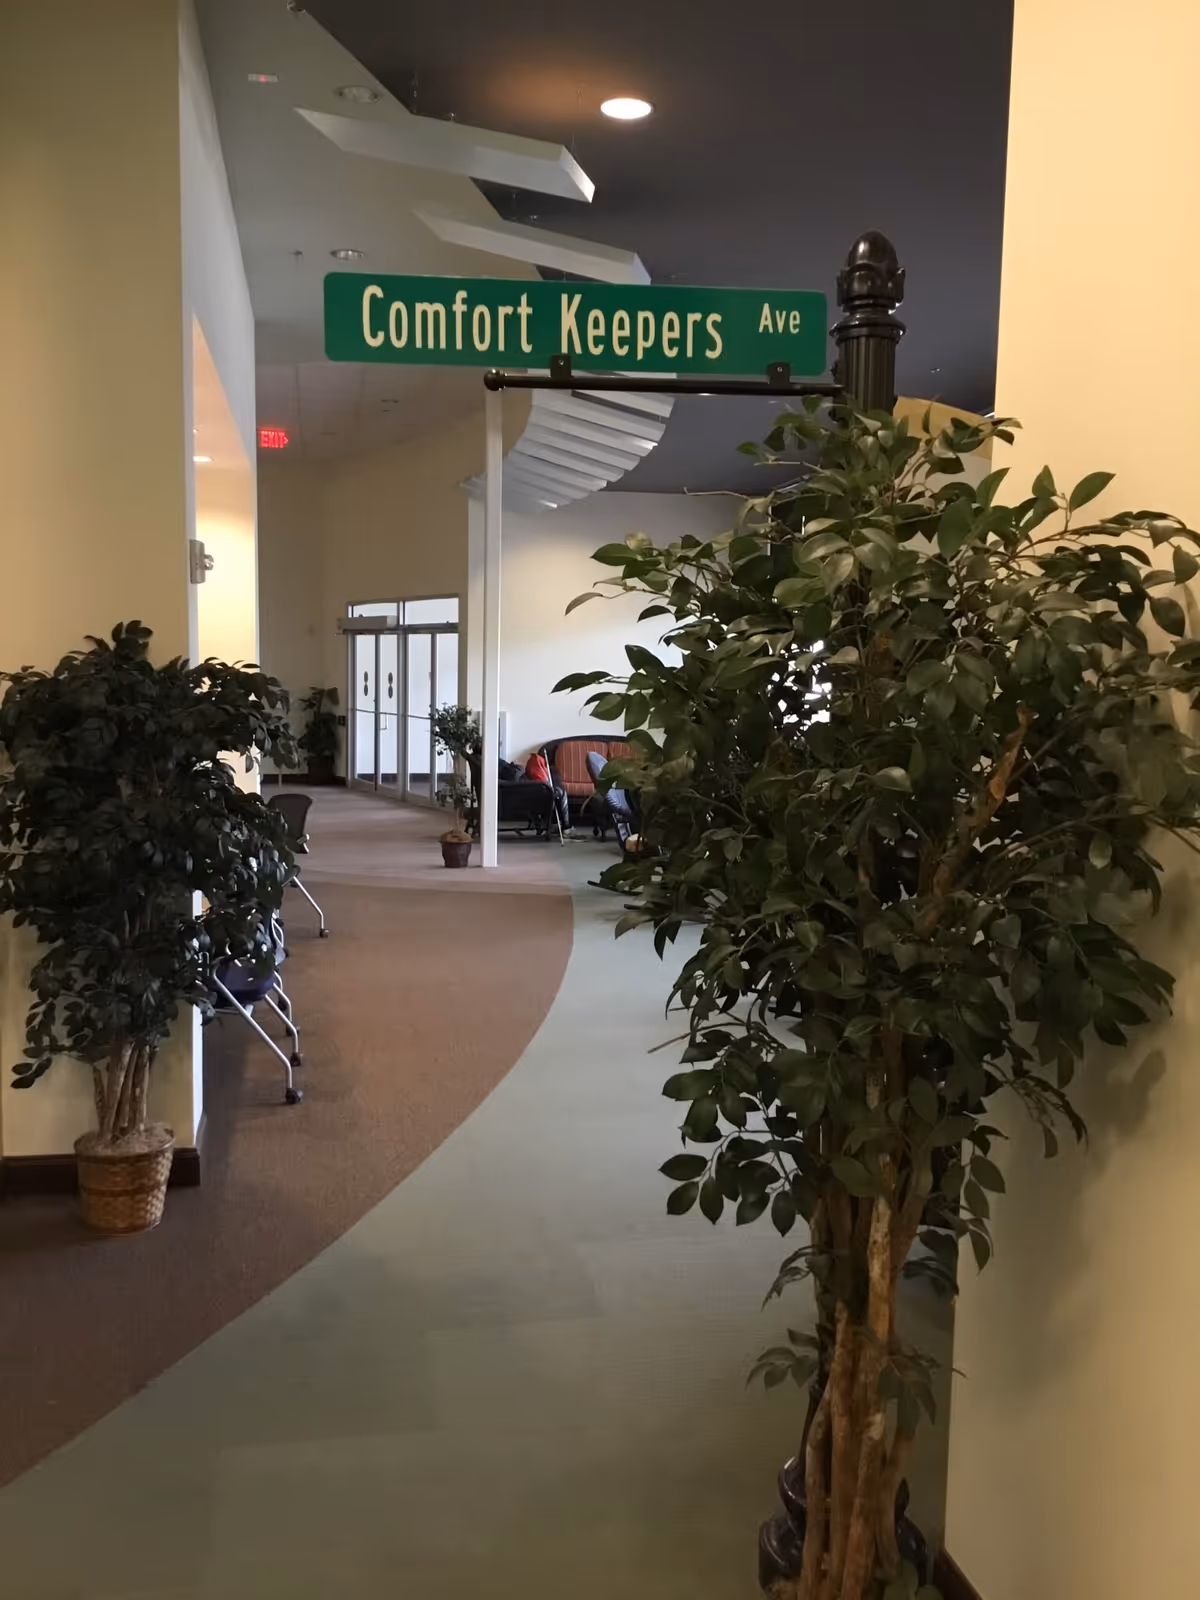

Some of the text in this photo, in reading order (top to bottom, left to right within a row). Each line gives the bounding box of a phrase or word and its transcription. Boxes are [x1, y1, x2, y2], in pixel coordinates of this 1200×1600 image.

[362, 284, 800, 361] Comfort Keepers Ave
[260, 430, 286, 448] EXIT
